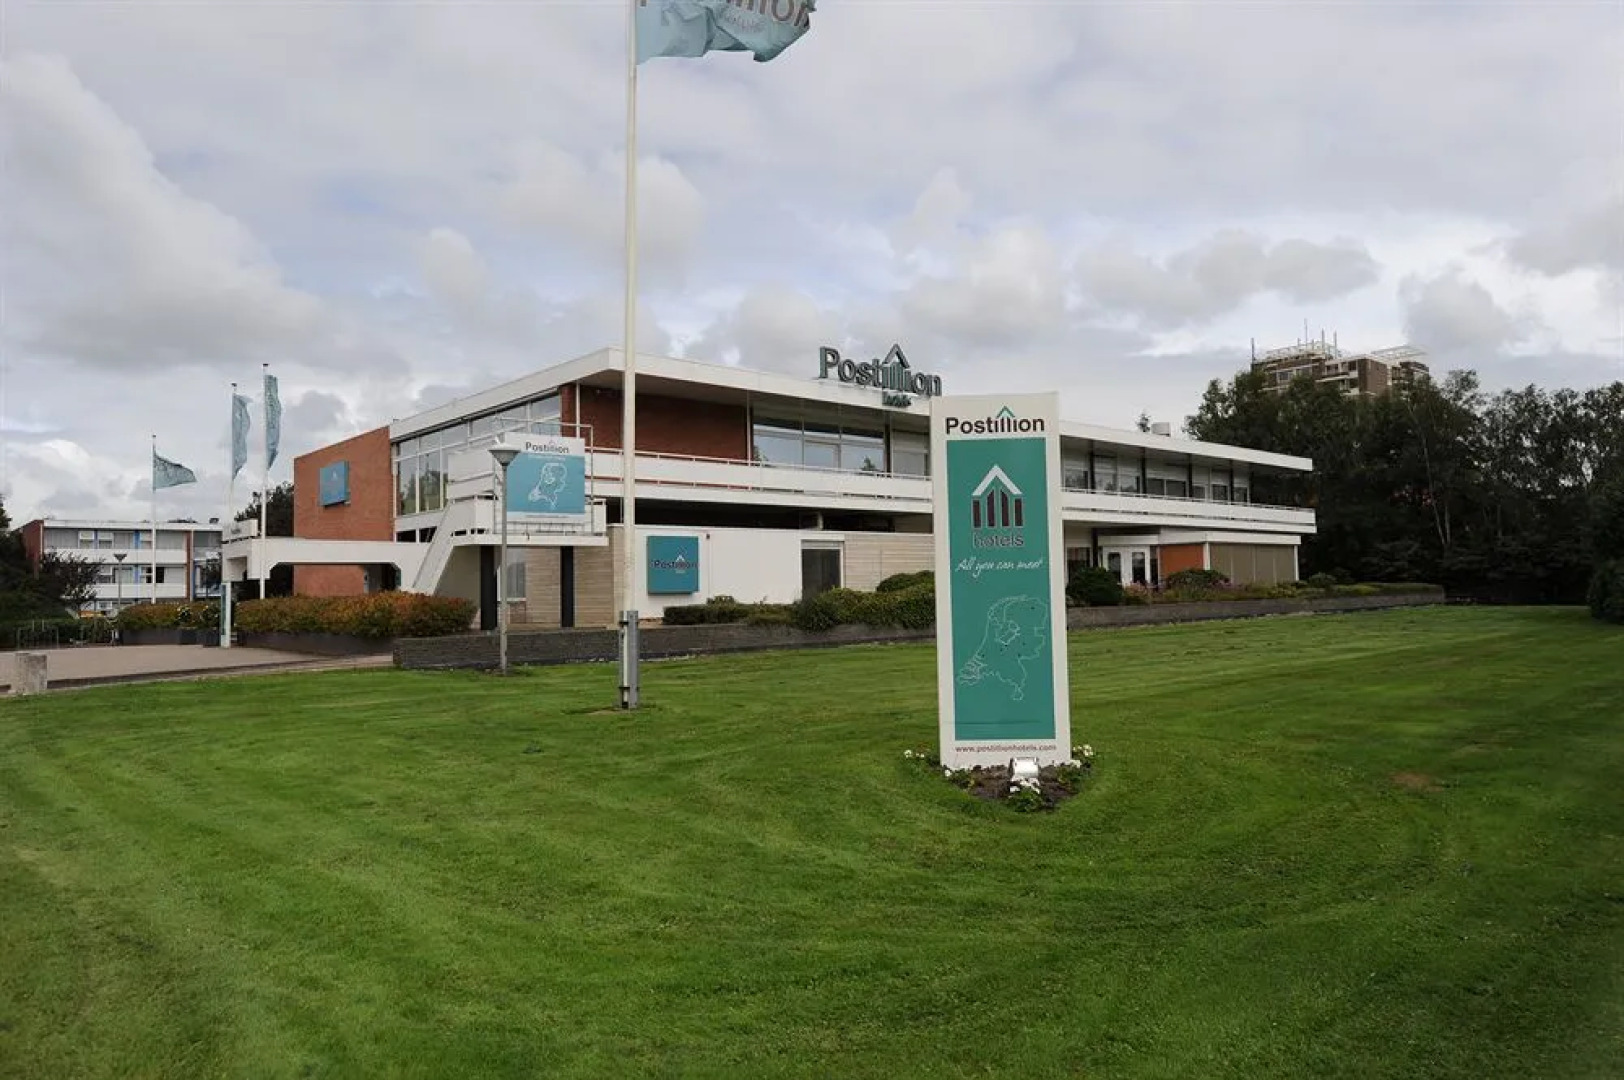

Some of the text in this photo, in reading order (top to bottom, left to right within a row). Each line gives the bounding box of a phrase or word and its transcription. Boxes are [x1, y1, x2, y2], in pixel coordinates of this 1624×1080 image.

[819, 346, 942, 397] Postillion
[945, 416, 1045, 435] Postillion
[525, 441, 569, 454] Postillion
[973, 532, 1024, 548] hotels
[956, 556, 976, 571] All
[973, 561, 994, 578] you
